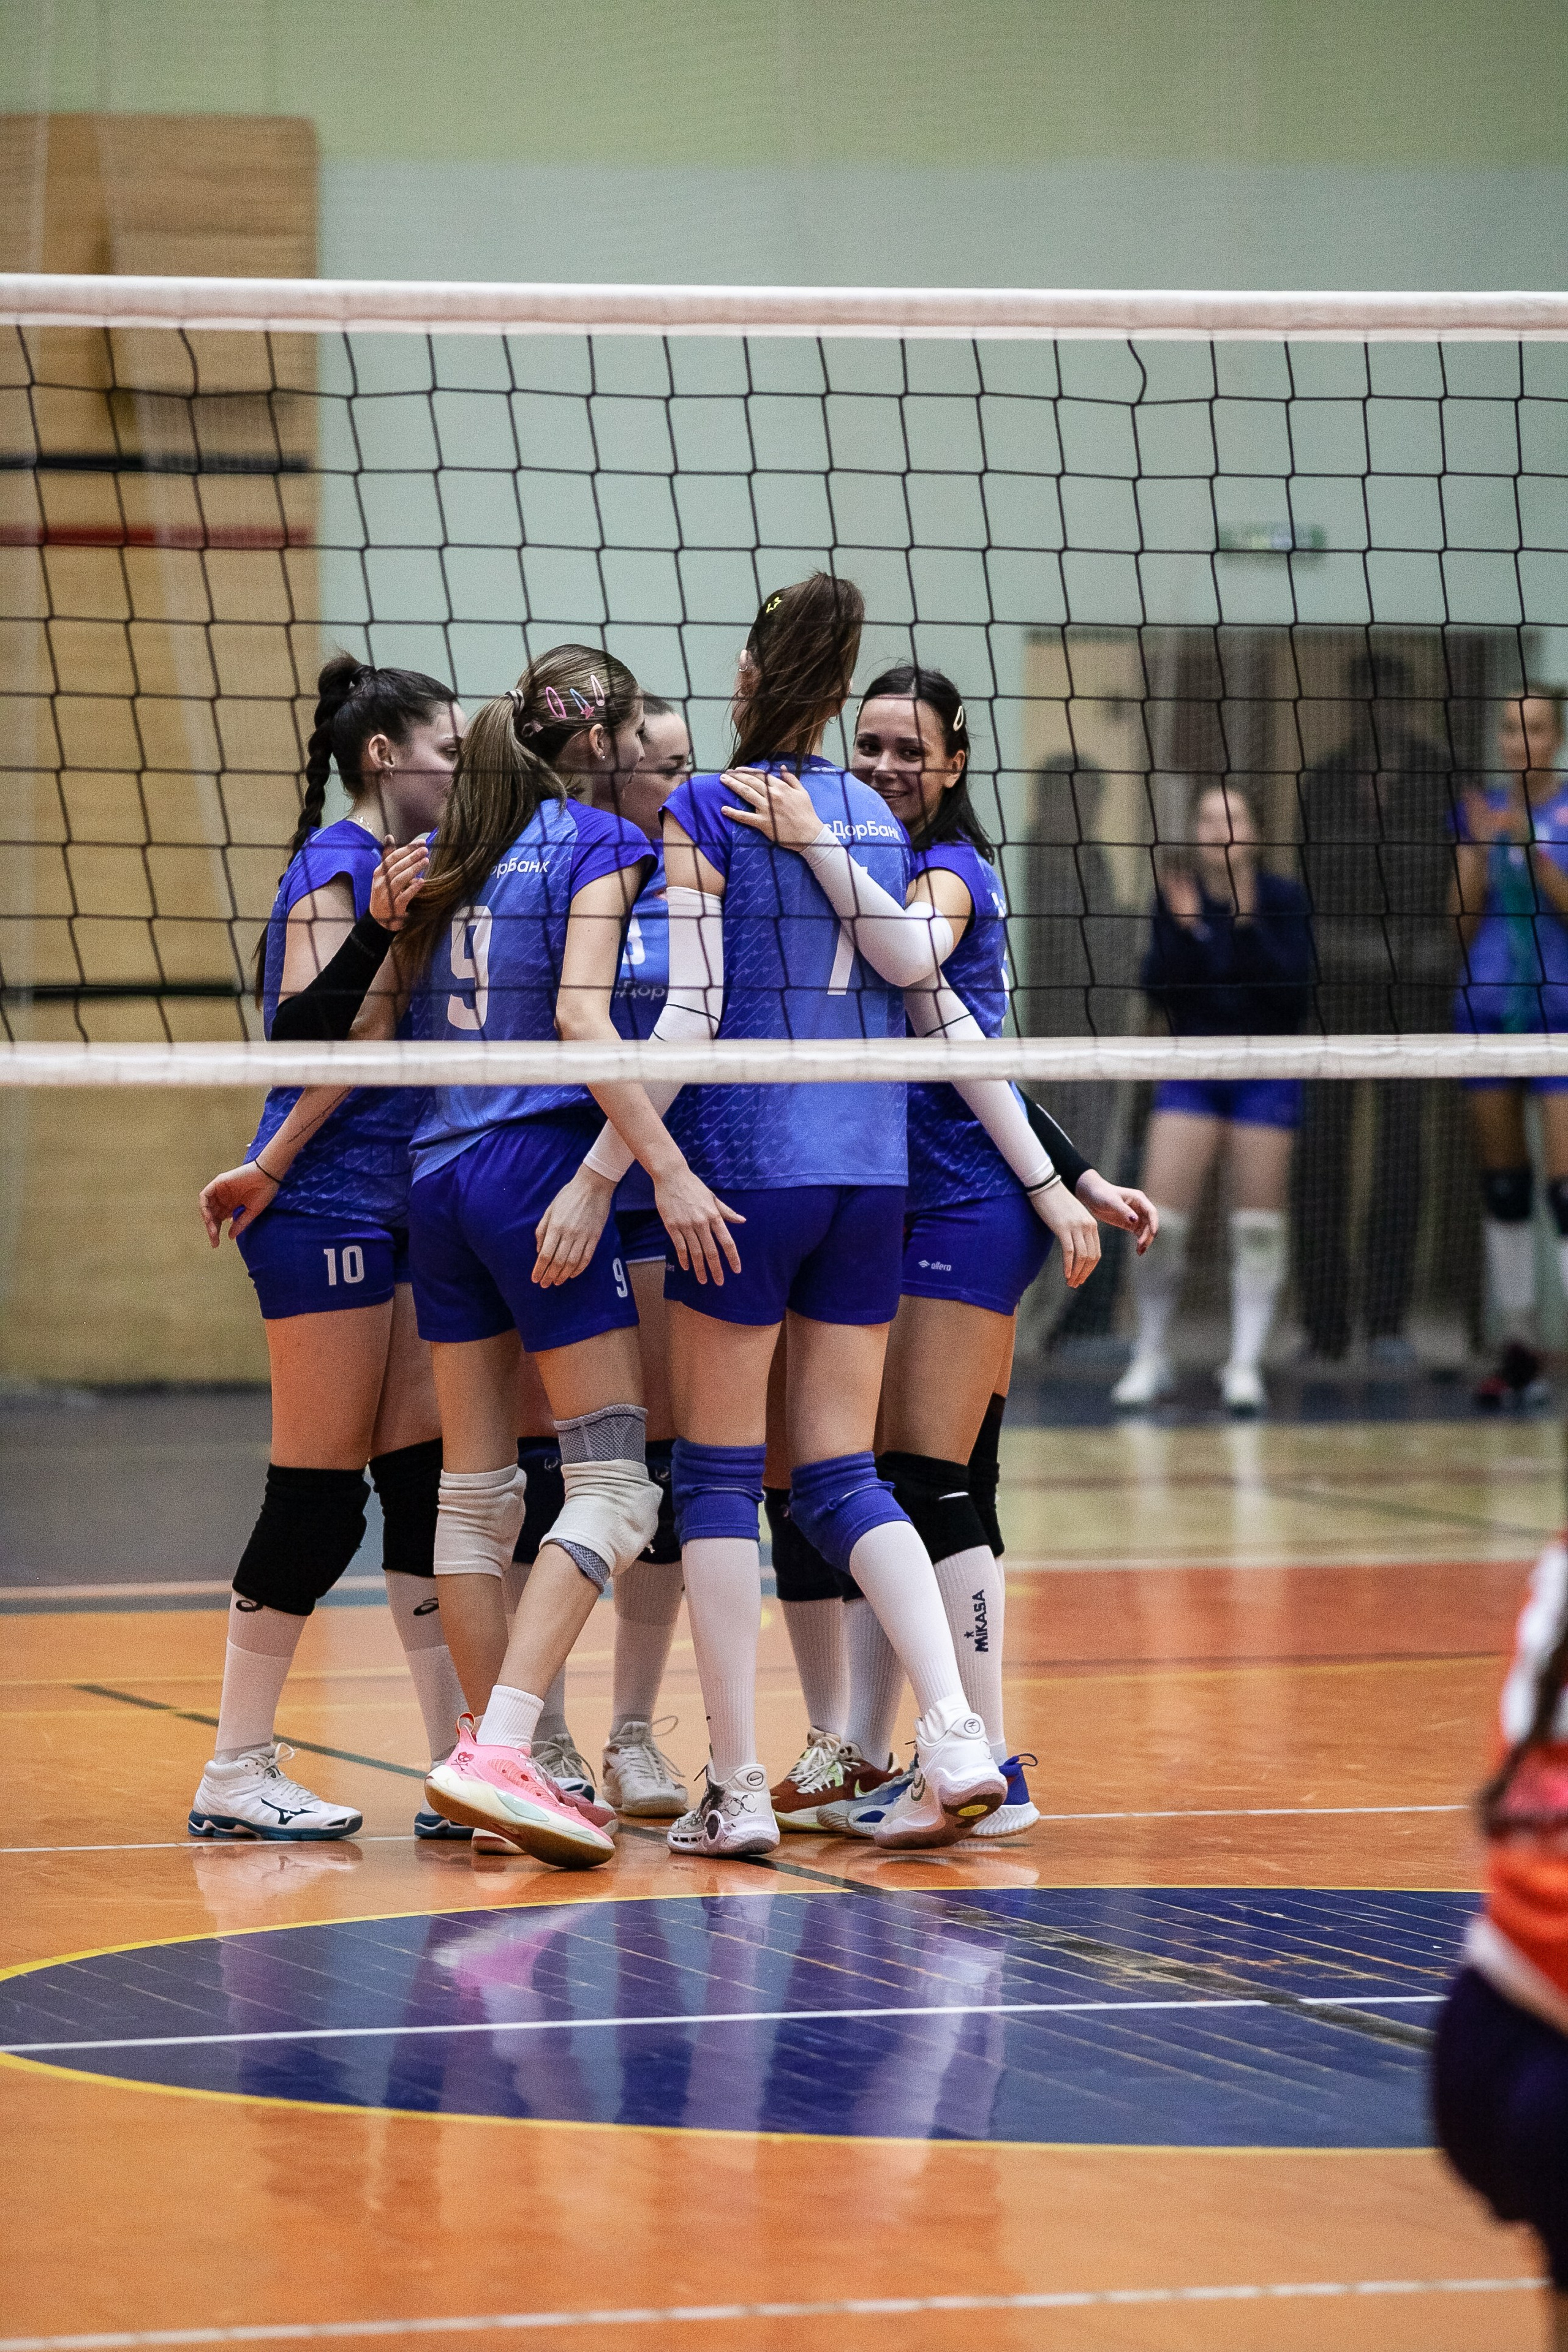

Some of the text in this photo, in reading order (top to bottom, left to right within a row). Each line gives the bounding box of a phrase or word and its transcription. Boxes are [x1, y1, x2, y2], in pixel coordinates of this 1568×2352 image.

[448, 906, 492, 1030] 9
[323, 1245, 364, 1286] 10
[612, 1257, 628, 1298] 9
[972, 1589, 989, 1652] MIKASA
